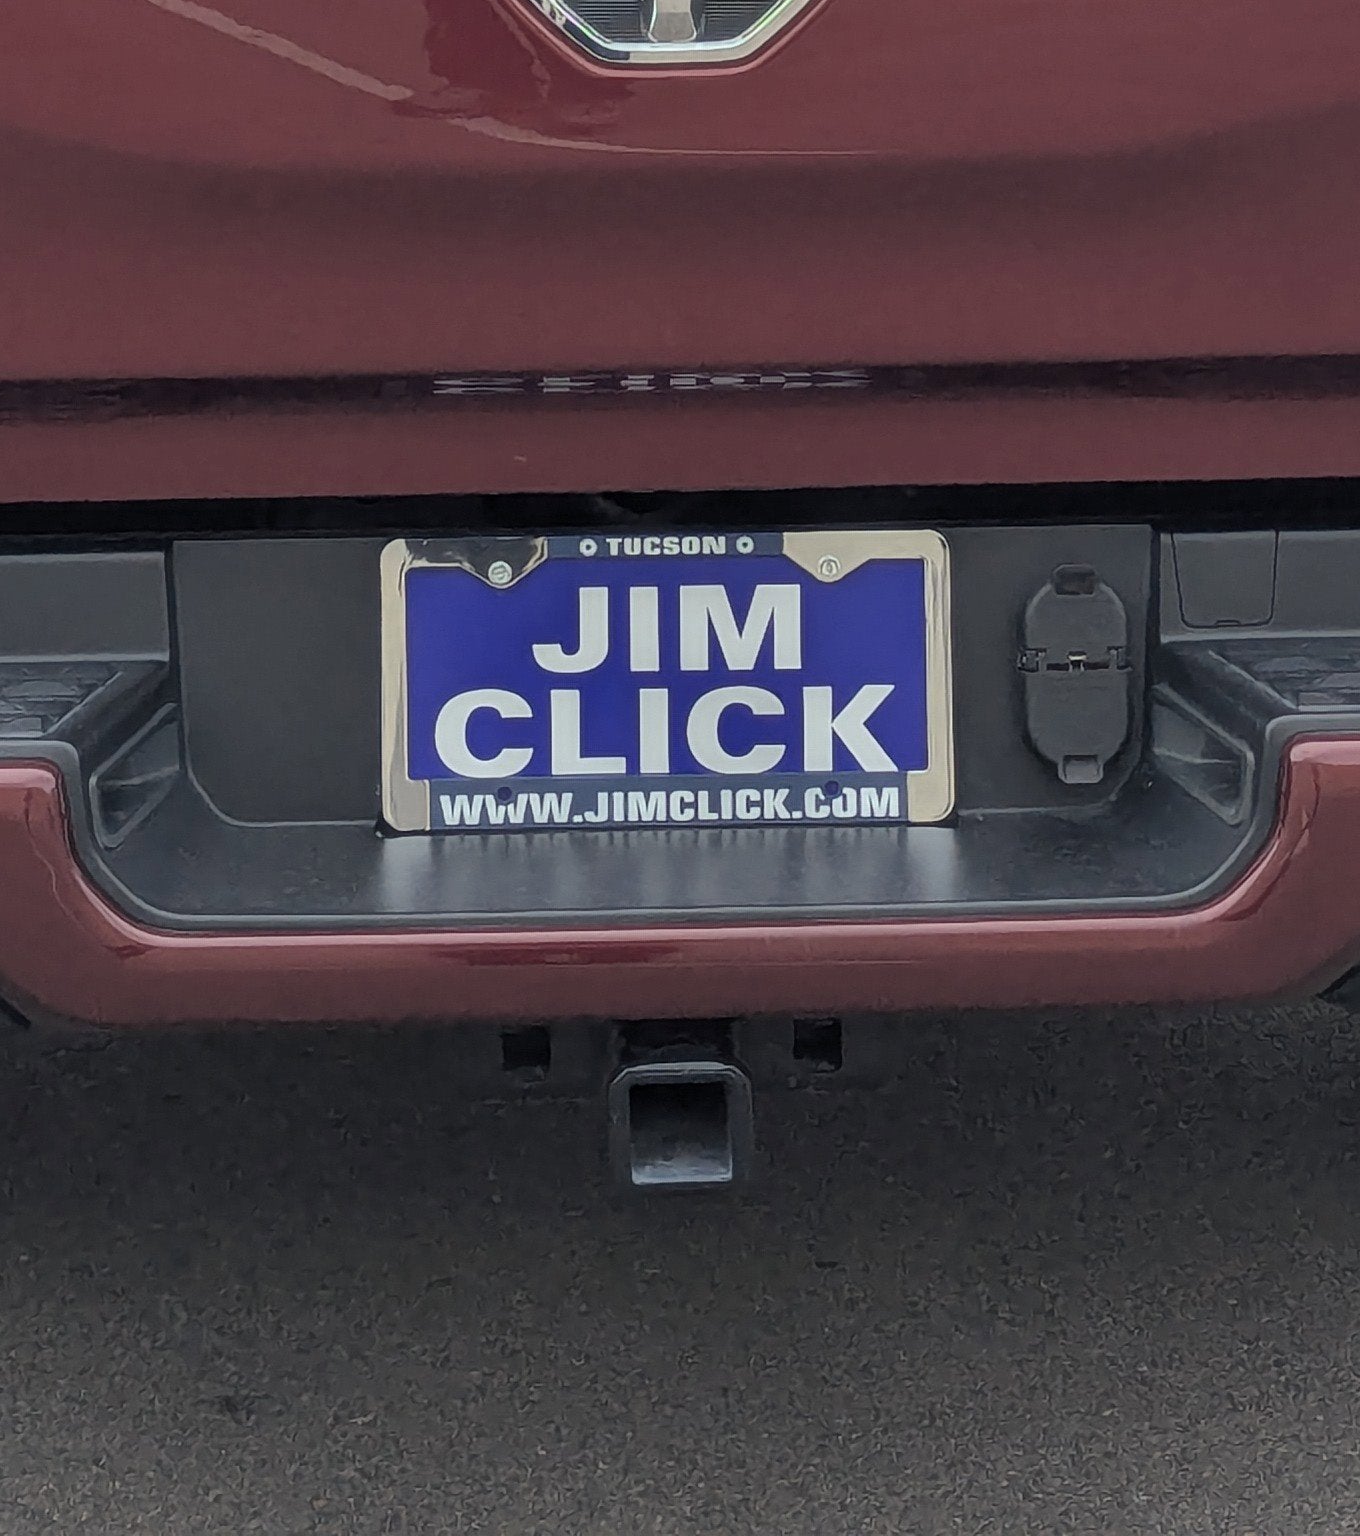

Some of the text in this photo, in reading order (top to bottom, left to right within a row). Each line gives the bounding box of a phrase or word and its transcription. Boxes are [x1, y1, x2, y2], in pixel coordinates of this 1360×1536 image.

[606, 537, 727, 556] TUCSON
[532, 584, 802, 673] JIM
[434, 684, 898, 777] CLICK
[440, 787, 900, 826] WWW.JIMCLICK.COM
